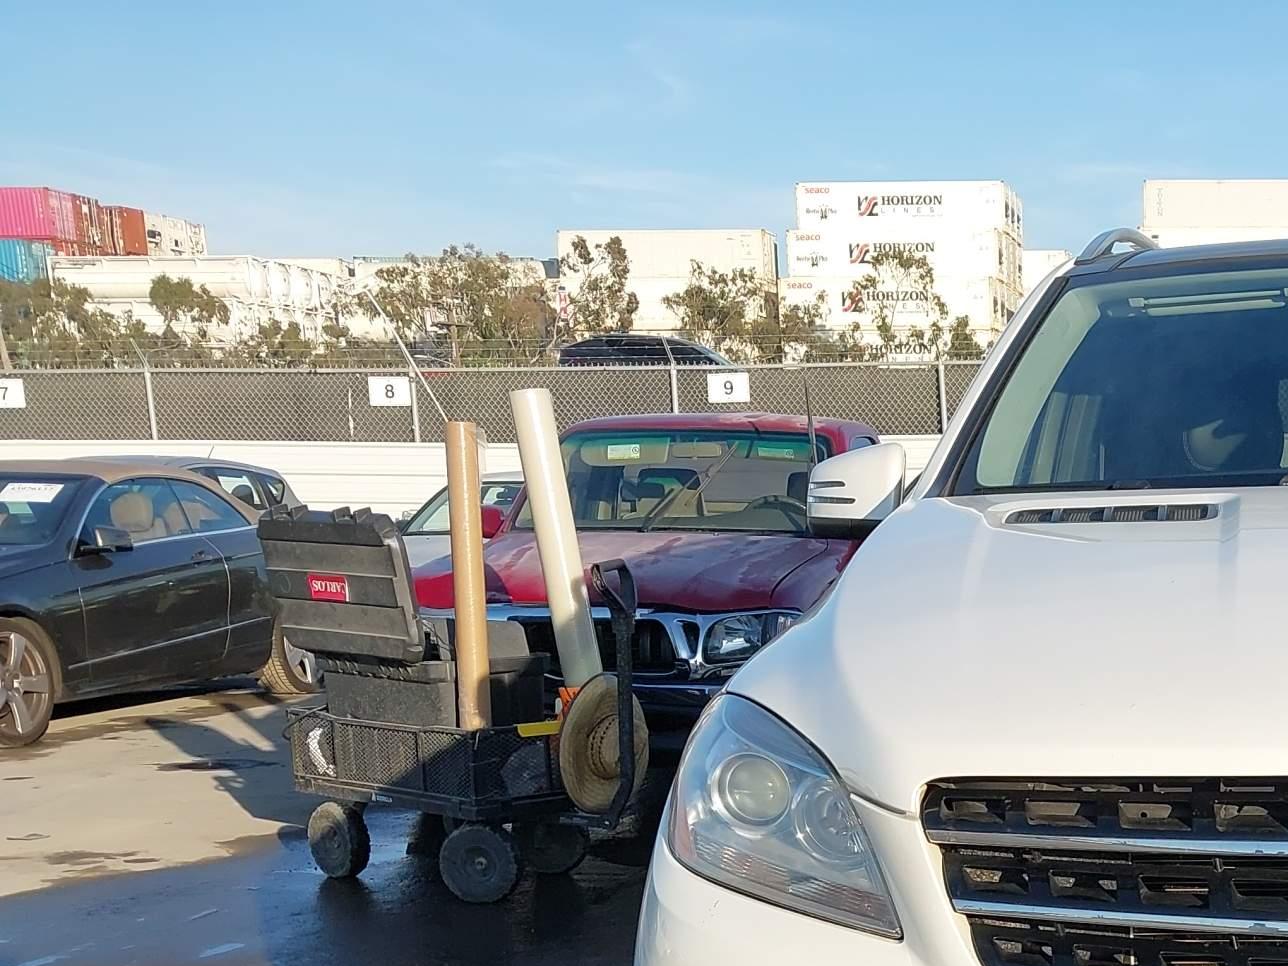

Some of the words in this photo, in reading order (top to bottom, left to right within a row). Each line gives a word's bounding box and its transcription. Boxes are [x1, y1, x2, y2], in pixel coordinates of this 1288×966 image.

[804, 186, 830, 194] seaco
[881, 195, 943, 206] HORIZON
[795, 233, 821, 241] seaco
[0, 386, 8, 400] 7
[384, 384, 395, 399] 8
[723, 380, 734, 395] 9
